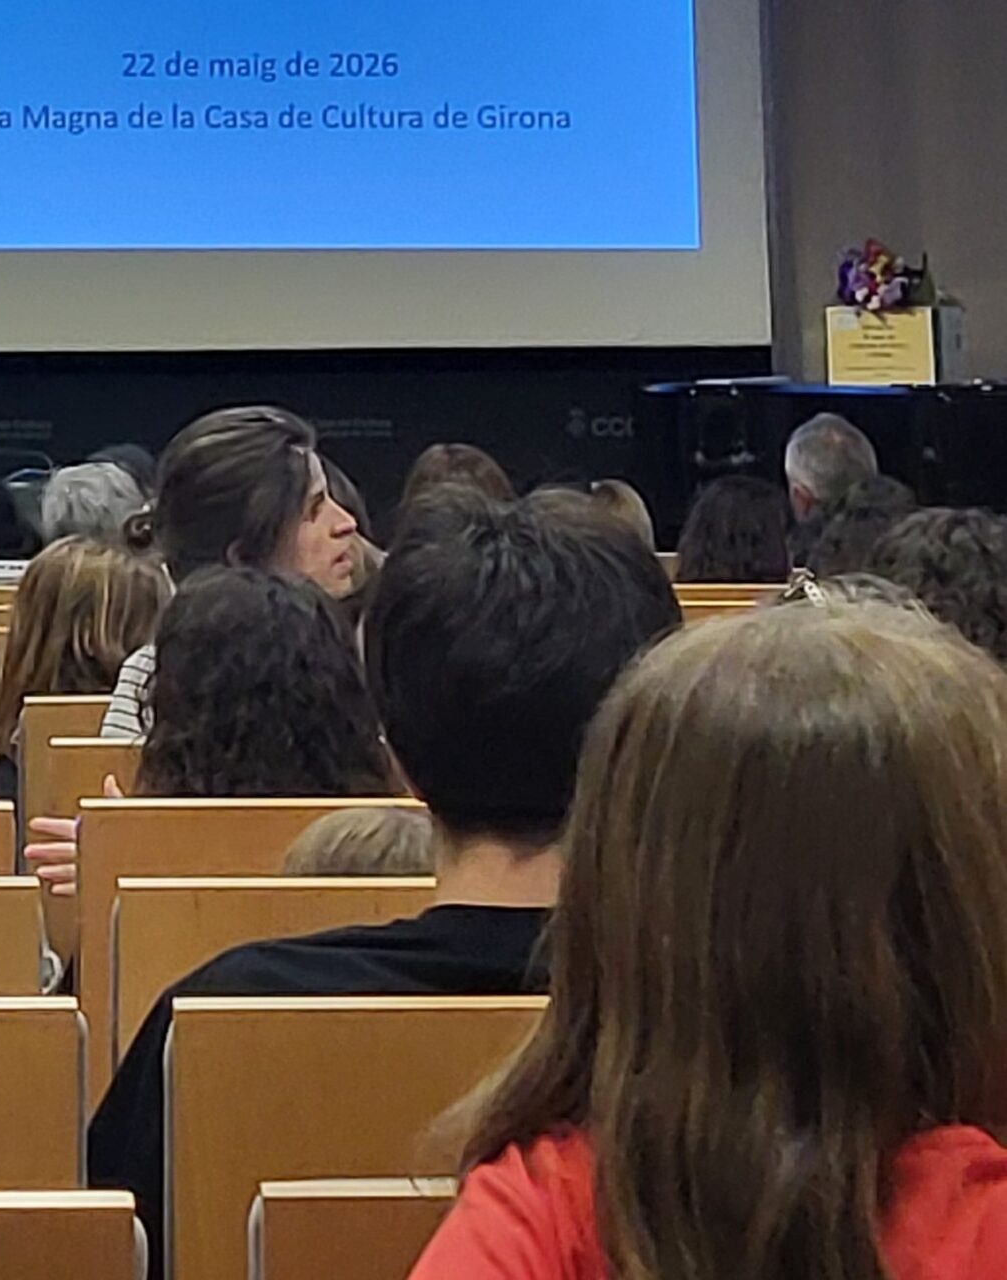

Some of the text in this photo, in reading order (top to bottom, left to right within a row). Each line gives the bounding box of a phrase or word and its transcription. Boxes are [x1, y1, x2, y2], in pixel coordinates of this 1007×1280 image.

[122, 50, 399, 84] 22 de maig de 2026
[22, 104, 119, 136] Magna
[127, 102, 164, 129] de
[172, 102, 195, 129] la
[204, 104, 269, 129] Casa
[278, 103, 313, 129] de
[321, 102, 424, 129] Cultura
[433, 101, 468, 129] de
[477, 104, 571, 130] Girona
